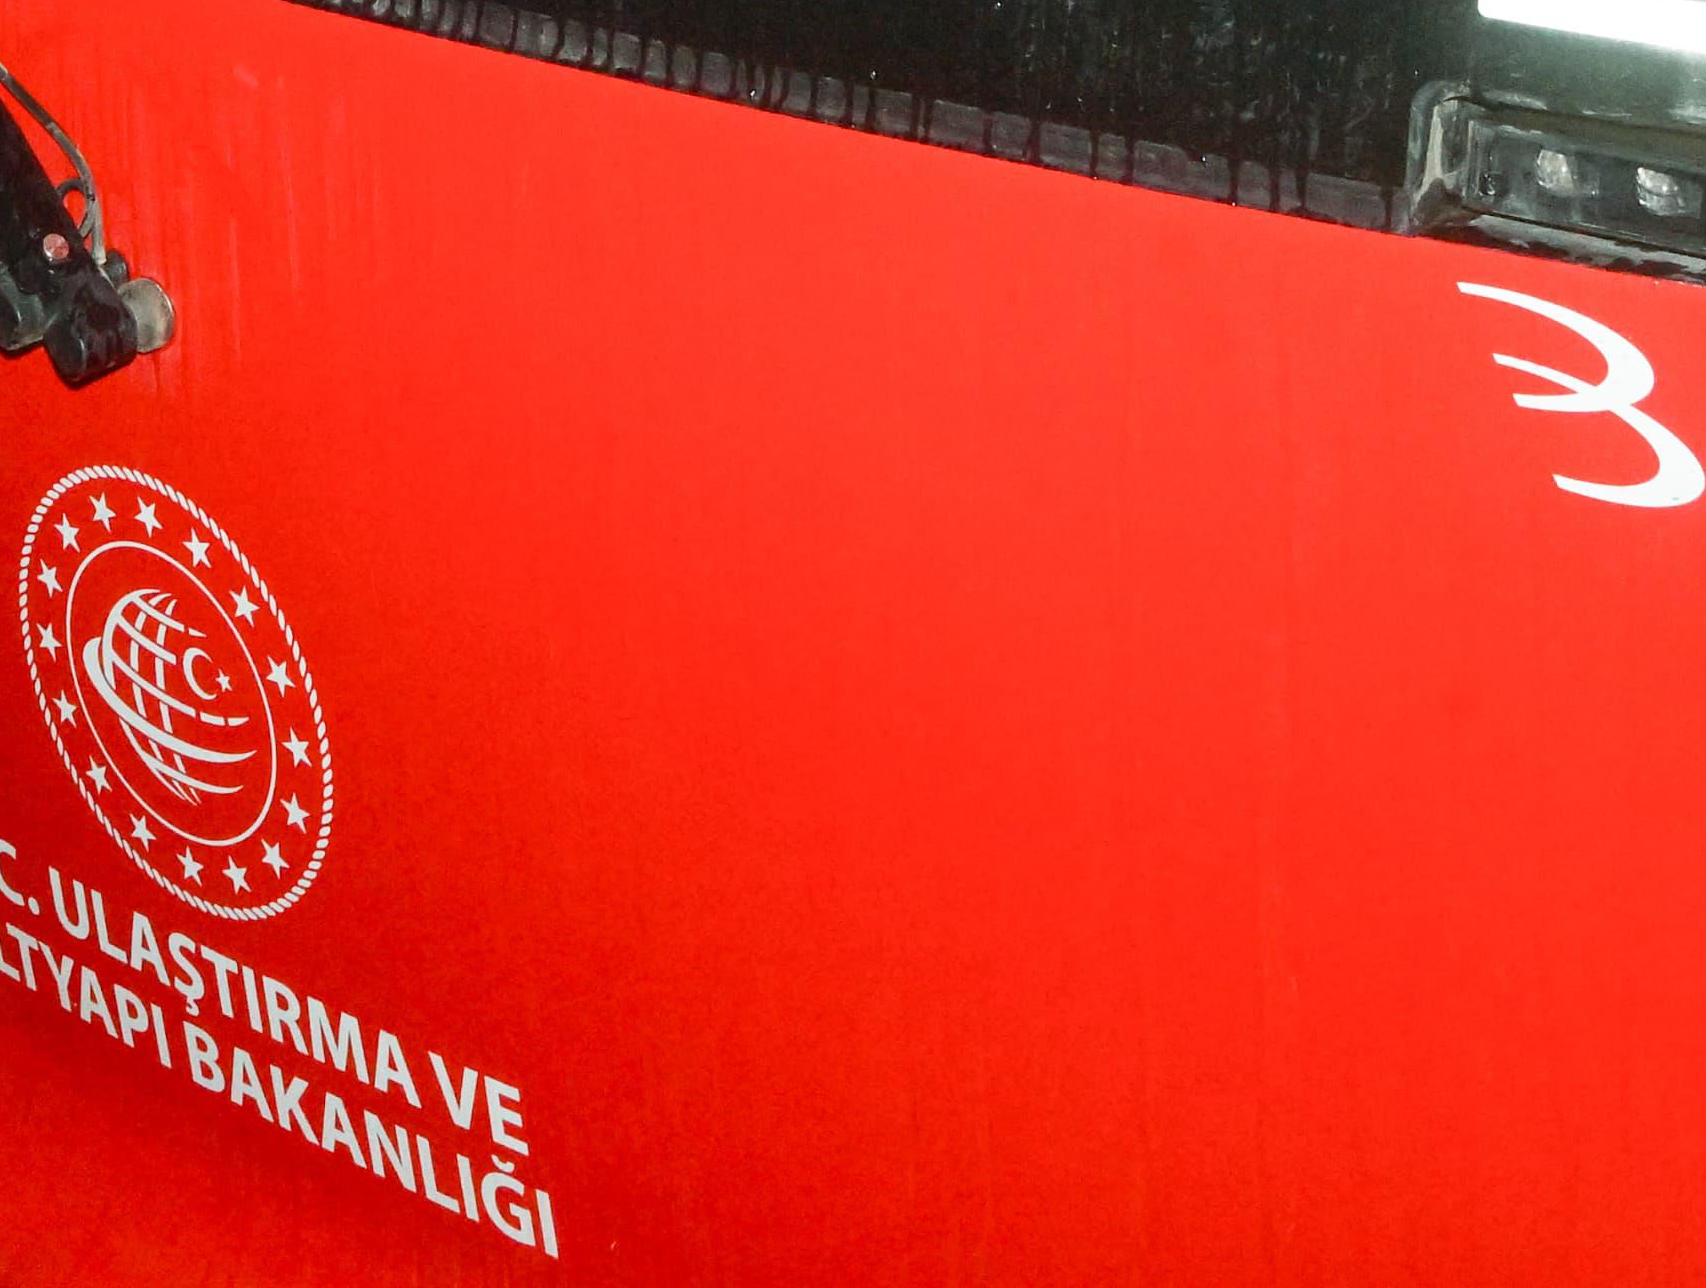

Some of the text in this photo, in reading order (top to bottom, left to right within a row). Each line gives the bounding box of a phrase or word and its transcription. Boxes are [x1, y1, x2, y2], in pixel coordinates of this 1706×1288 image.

[48, 866, 422, 1109] ULAŞTIRMA
[428, 1051, 529, 1156] VE
[183, 1020, 559, 1259] BAKANLIĞI
